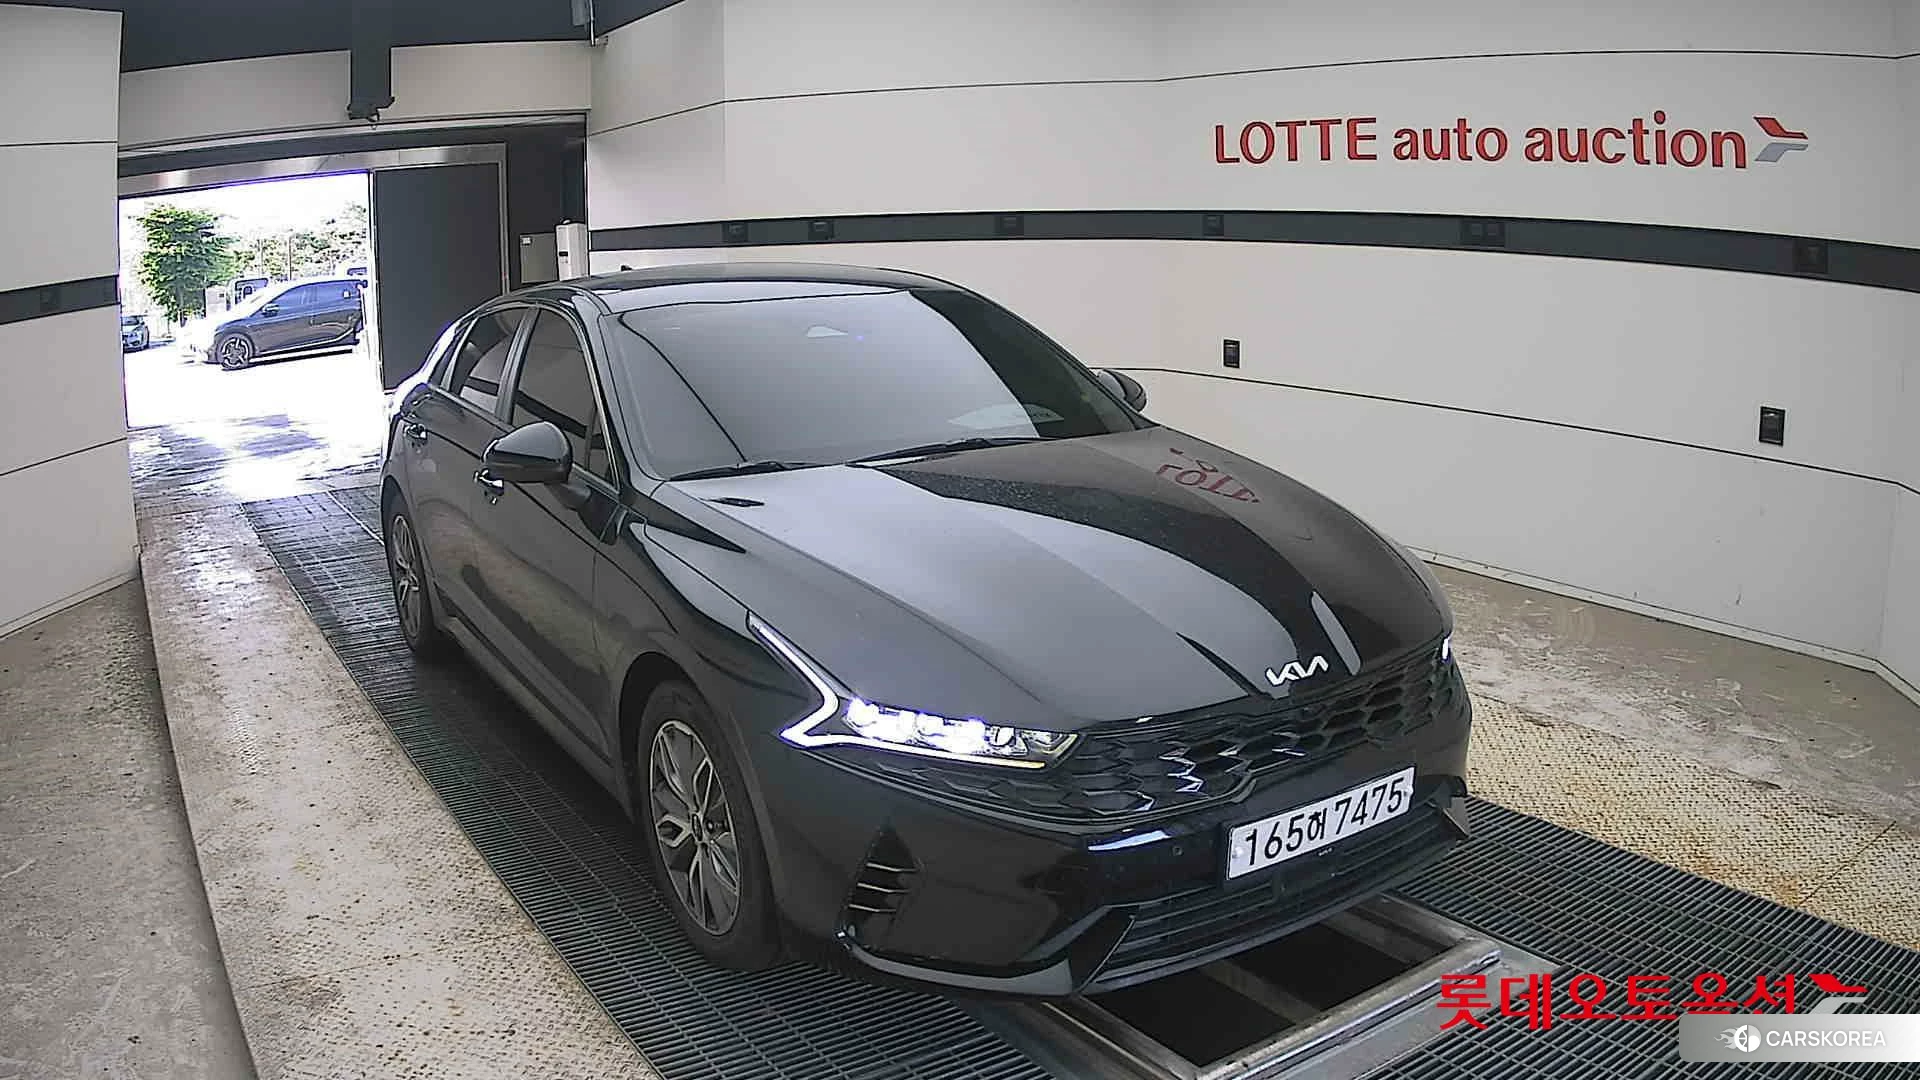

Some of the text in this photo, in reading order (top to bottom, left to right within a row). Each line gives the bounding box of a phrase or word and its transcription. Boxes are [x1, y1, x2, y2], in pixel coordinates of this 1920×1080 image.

[1214, 110, 1748, 169] LOTTE auto auction
[1266, 655, 1329, 686] KIA
